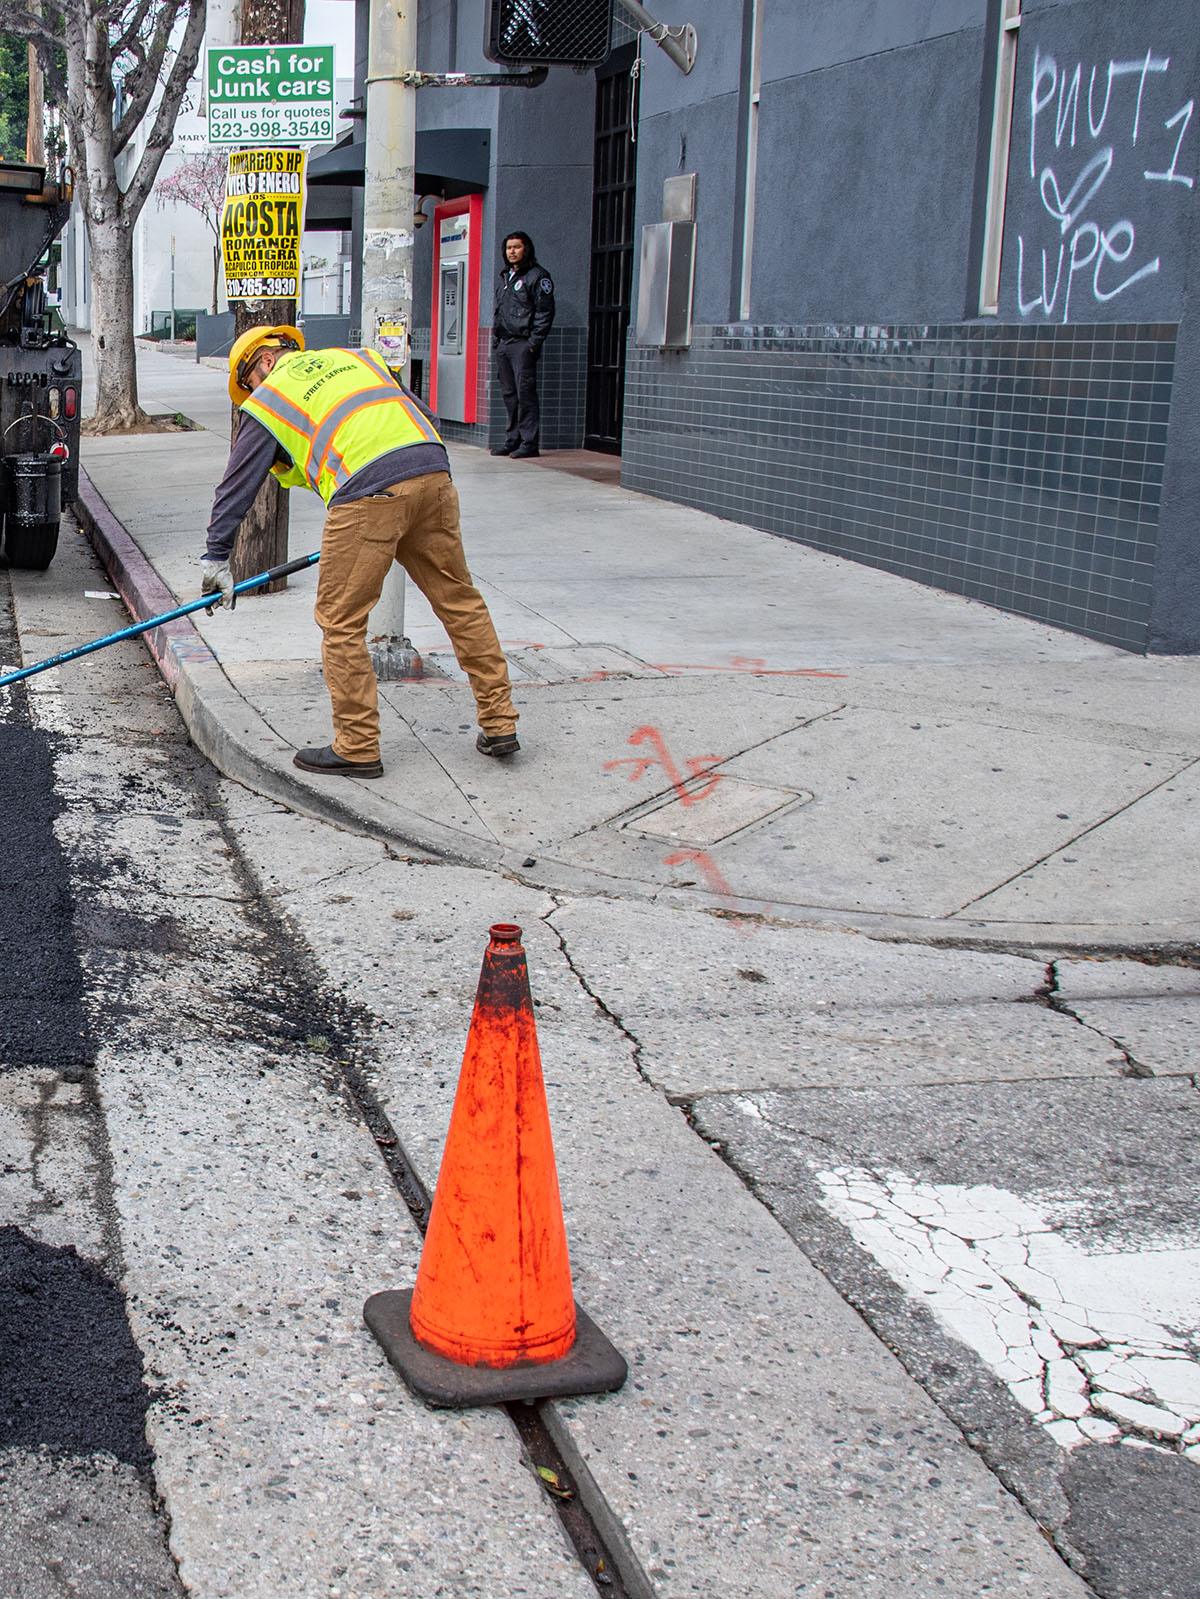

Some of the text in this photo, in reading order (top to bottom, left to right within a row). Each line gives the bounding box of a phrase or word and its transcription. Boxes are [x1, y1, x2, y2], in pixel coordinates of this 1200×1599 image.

[218, 54, 324, 75] Cash for
[209, 78, 331, 97] Junk cars
[211, 107, 330, 120] Call us for quotes
[211, 121, 330, 138] 323-998-3549
[286, 152, 301, 171] HP
[247, 173, 256, 193] 9
[258, 171, 300, 193] ENERO
[223, 201, 299, 237] ACOSTA
[226, 238, 298, 250] ROMANCE
[227, 249, 296, 261] LA MIGRA
[225, 261, 297, 271] ACAPULCO TROPICAL
[227, 278, 296, 296] 310-265-3930
[303, 378, 325, 402] STREET
[325, 364, 357, 379] SERVICES
